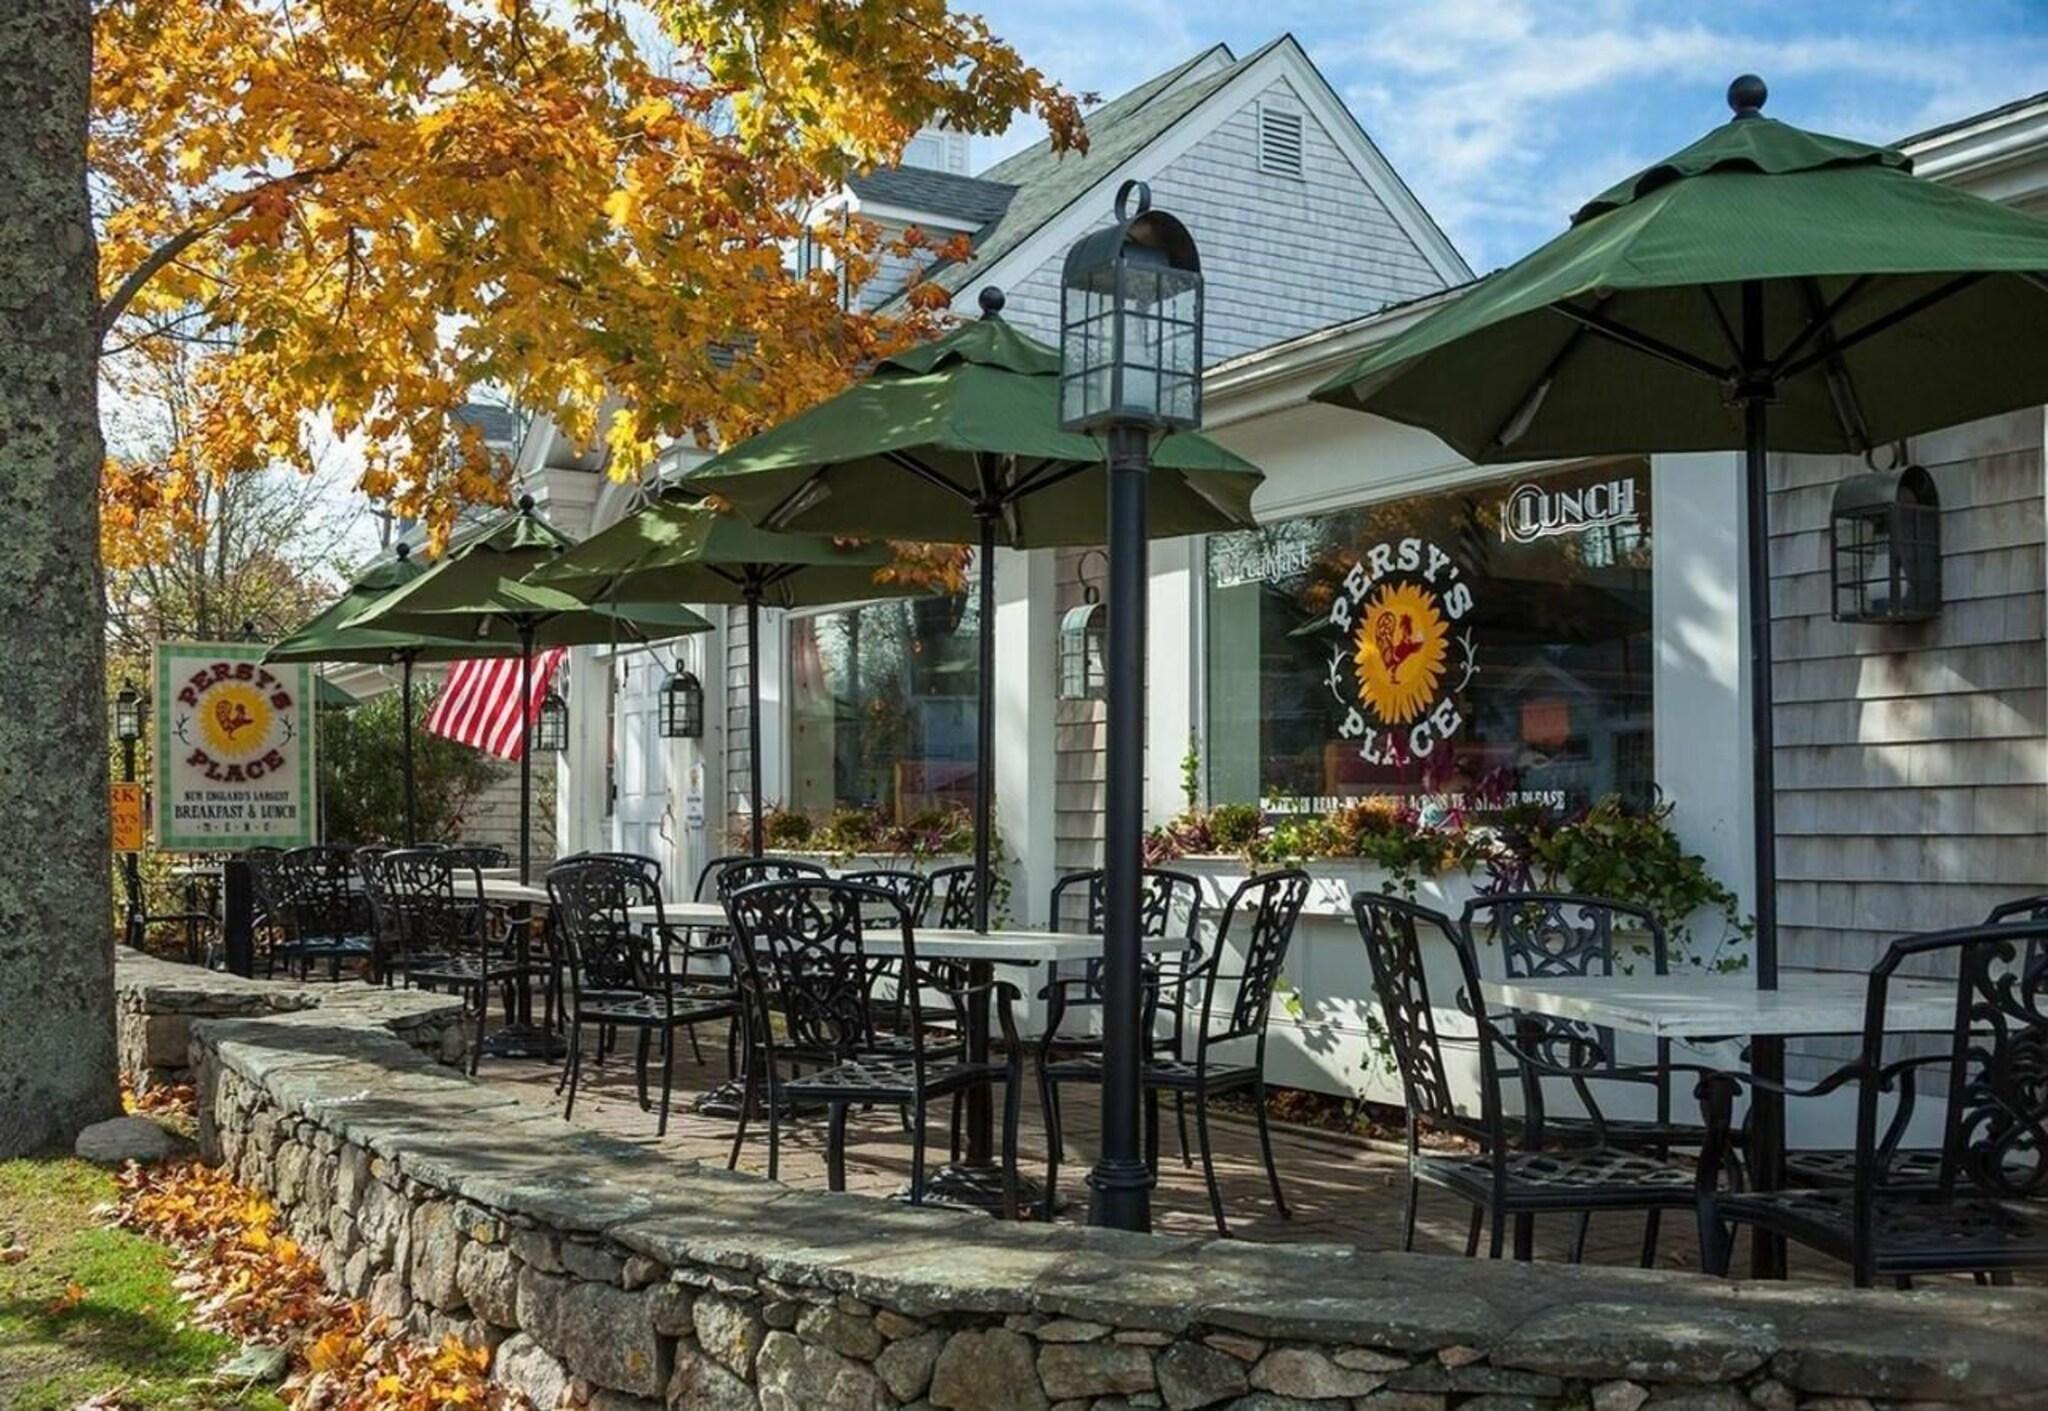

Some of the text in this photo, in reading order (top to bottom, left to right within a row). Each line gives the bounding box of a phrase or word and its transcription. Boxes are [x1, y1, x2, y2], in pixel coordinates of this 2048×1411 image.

[1507, 478, 1638, 543] LUNCH
[1329, 537, 1474, 633] PERSY'S
[177, 662, 293, 711] PERSY'S
[1338, 697, 1462, 766] PLACE
[186, 748, 286, 783] PLACE
[175, 804, 296, 819] BREAKFAST & LUNCH
[184, 791, 202, 801] NEW
